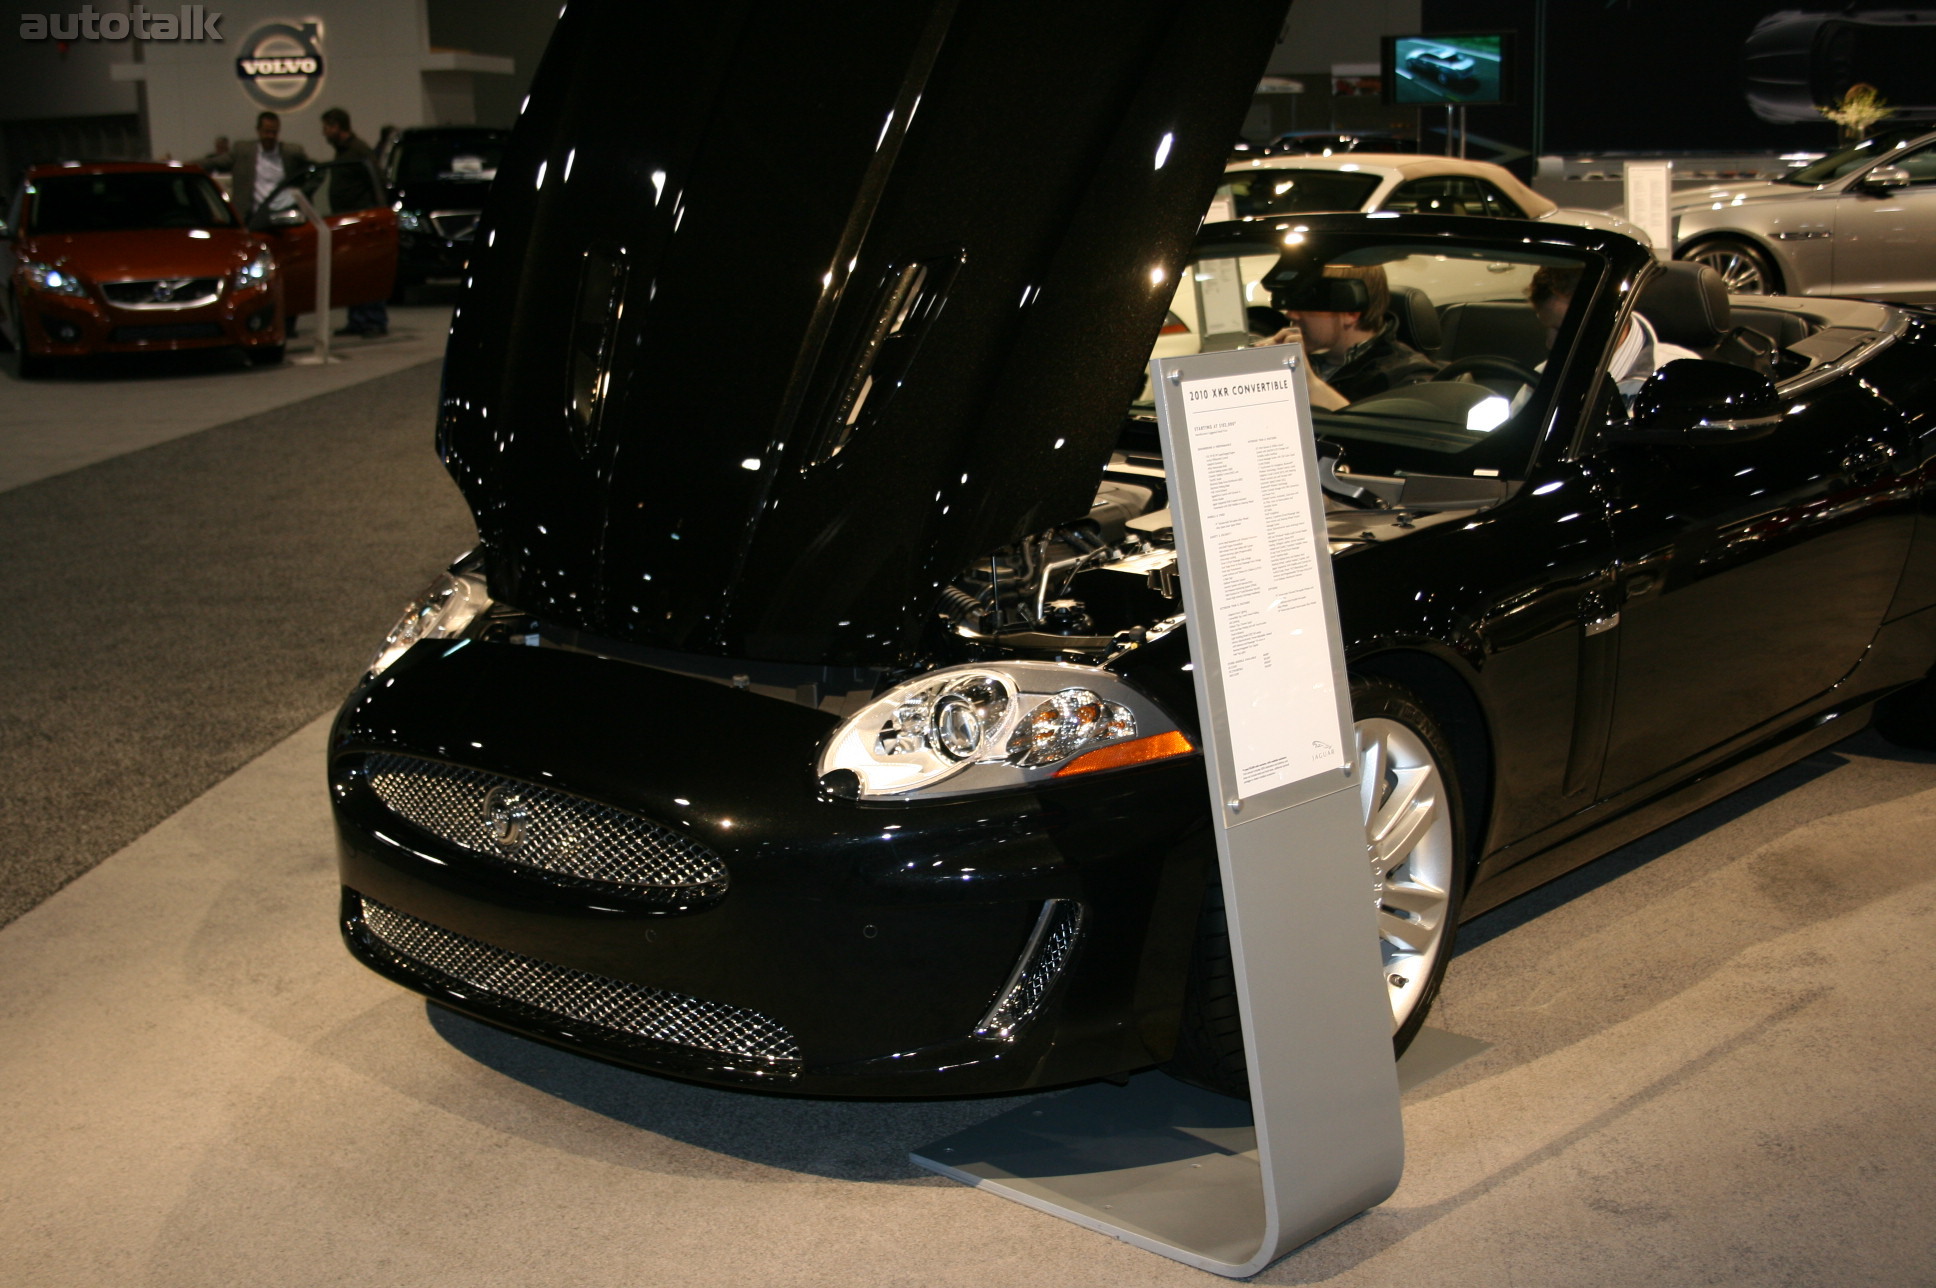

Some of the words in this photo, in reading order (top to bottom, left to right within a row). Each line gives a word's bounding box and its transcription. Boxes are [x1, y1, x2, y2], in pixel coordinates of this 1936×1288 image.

[241, 57, 318, 75] VOLVO
[1189, 389, 1209, 401] 2010
[1212, 387, 1229, 398] XKR
[1232, 380, 1288, 395] CONVERTIBLE
[1312, 749, 1335, 761] JAGUAR
